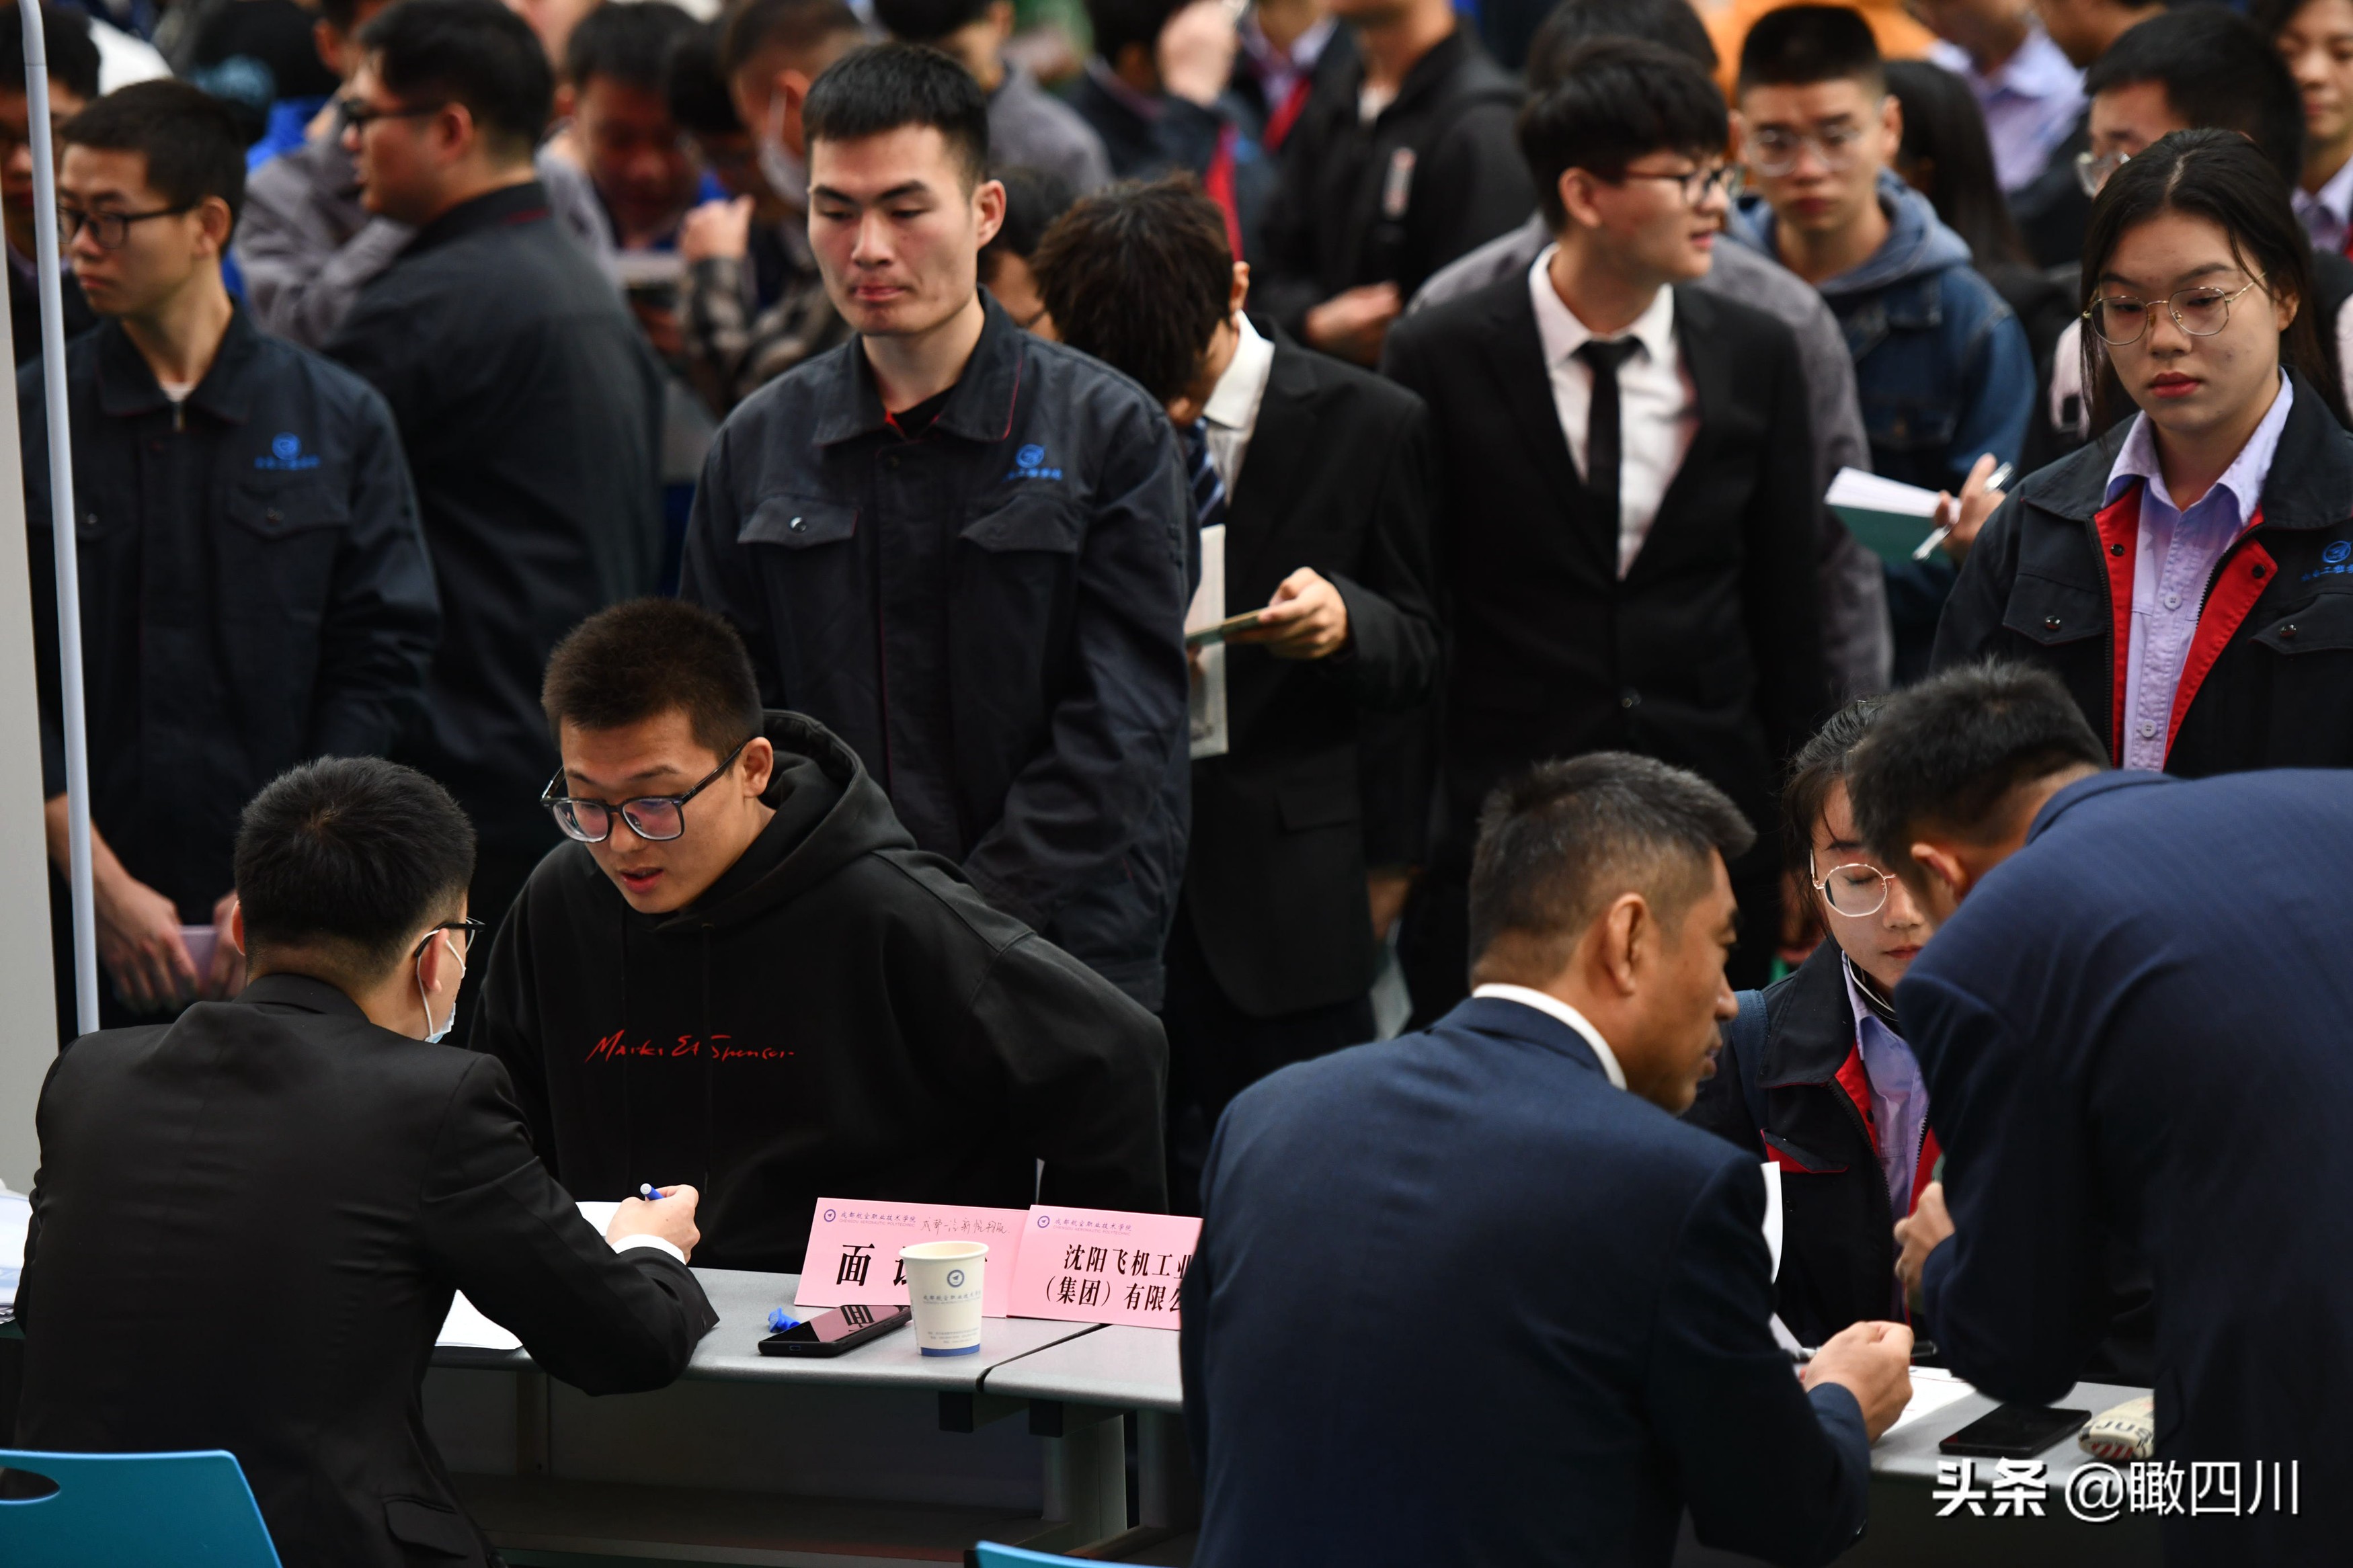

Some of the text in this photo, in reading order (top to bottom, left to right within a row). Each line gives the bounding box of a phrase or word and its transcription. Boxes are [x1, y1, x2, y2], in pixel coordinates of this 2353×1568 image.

[585, 1029, 664, 1063] Marks
[840, 1211, 916, 1223] 成都航空职业技术学院
[1055, 1218, 1132, 1232] 成都航空职业技术学院
